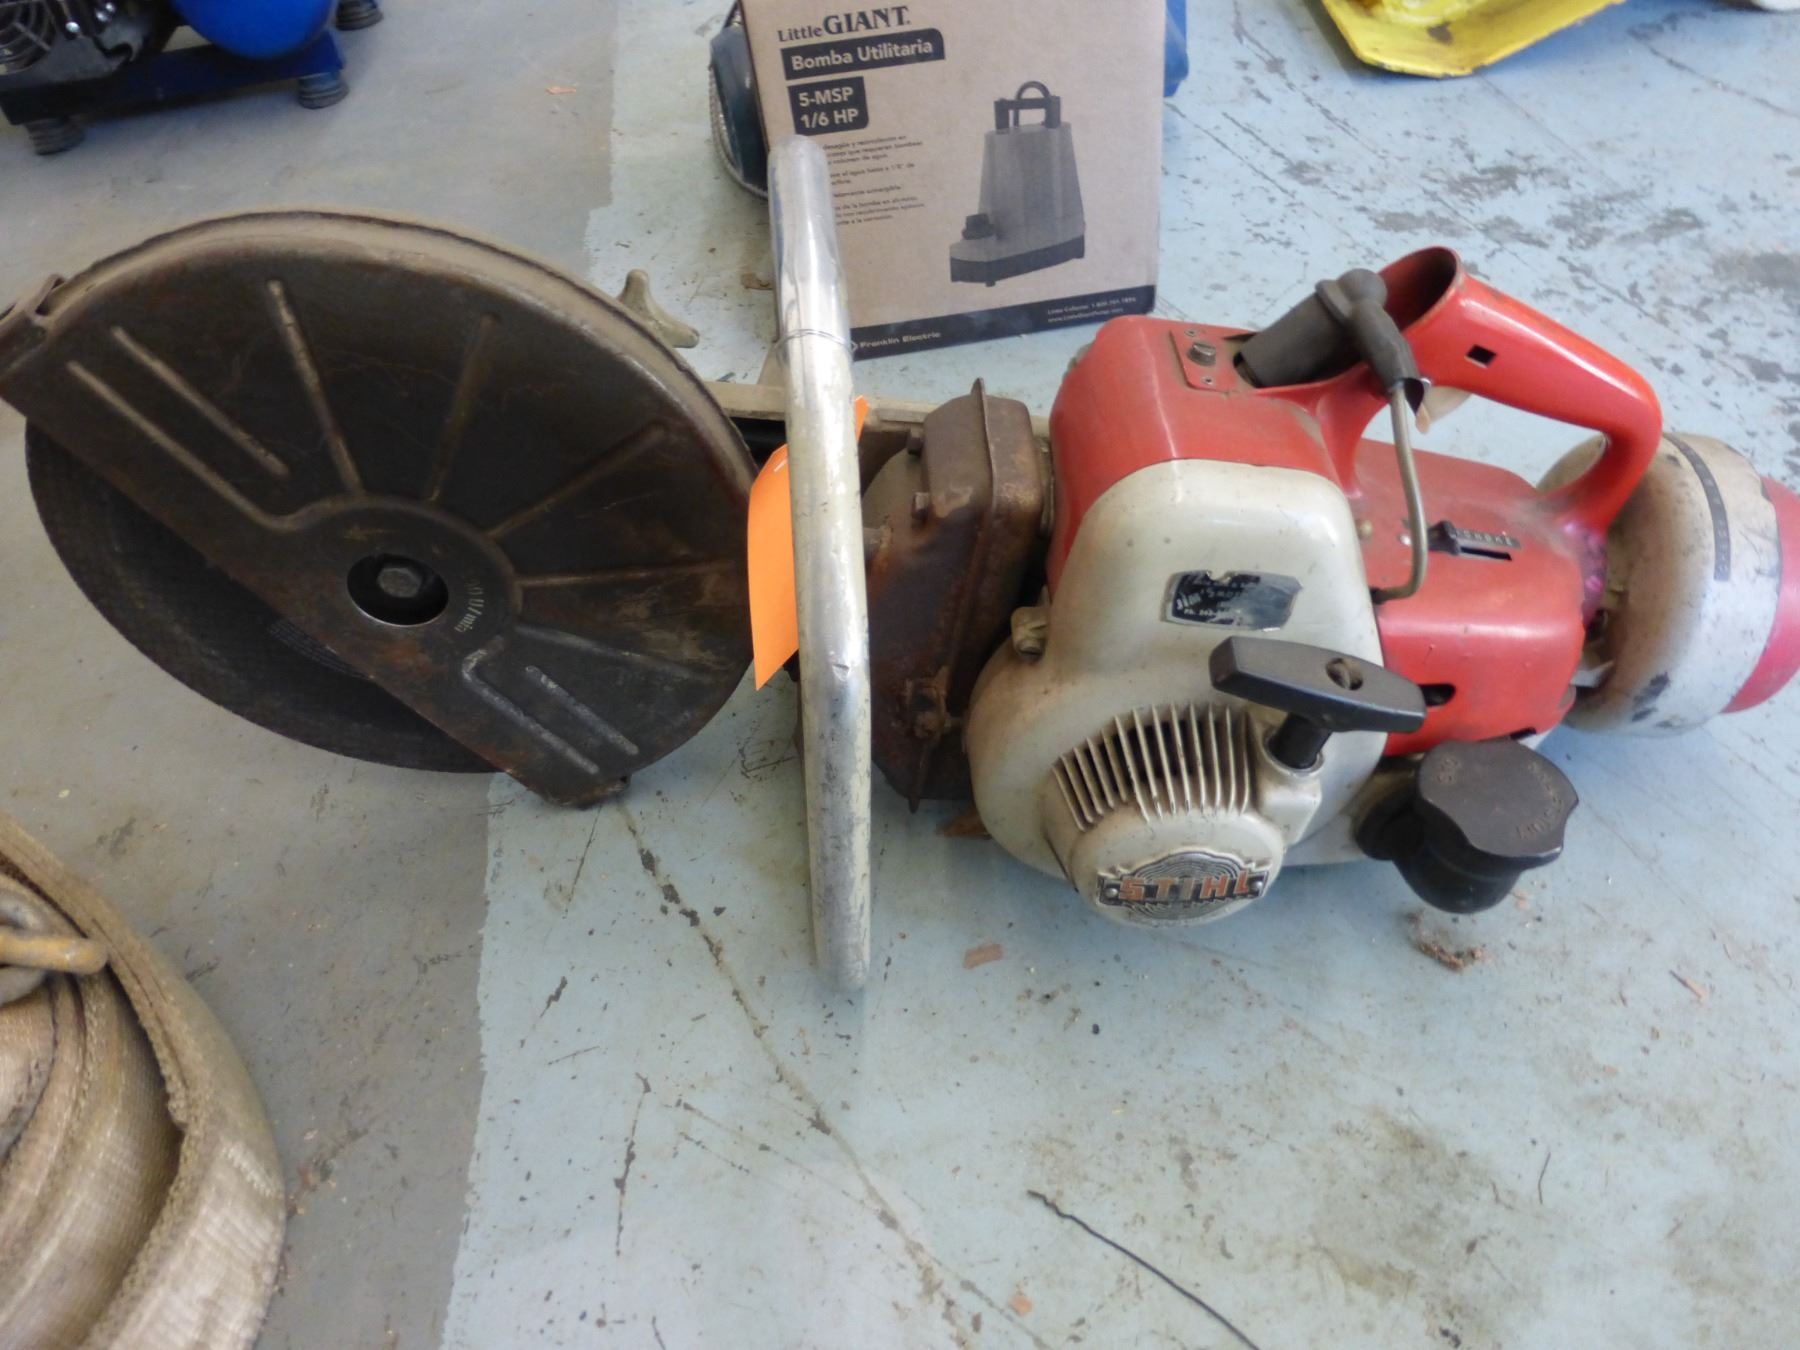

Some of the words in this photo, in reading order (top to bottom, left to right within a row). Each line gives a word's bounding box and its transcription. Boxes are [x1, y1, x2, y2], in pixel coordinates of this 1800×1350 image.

[777, 25, 823, 42] Little
[791, 50, 853, 71] Bomba
[857, 39, 933, 62] Utilitaria
[799, 87, 854, 107] 5-MSP
[800, 112, 829, 128] 1/6
[834, 108, 859, 124] HP
[1118, 870, 1250, 901] STIHL
